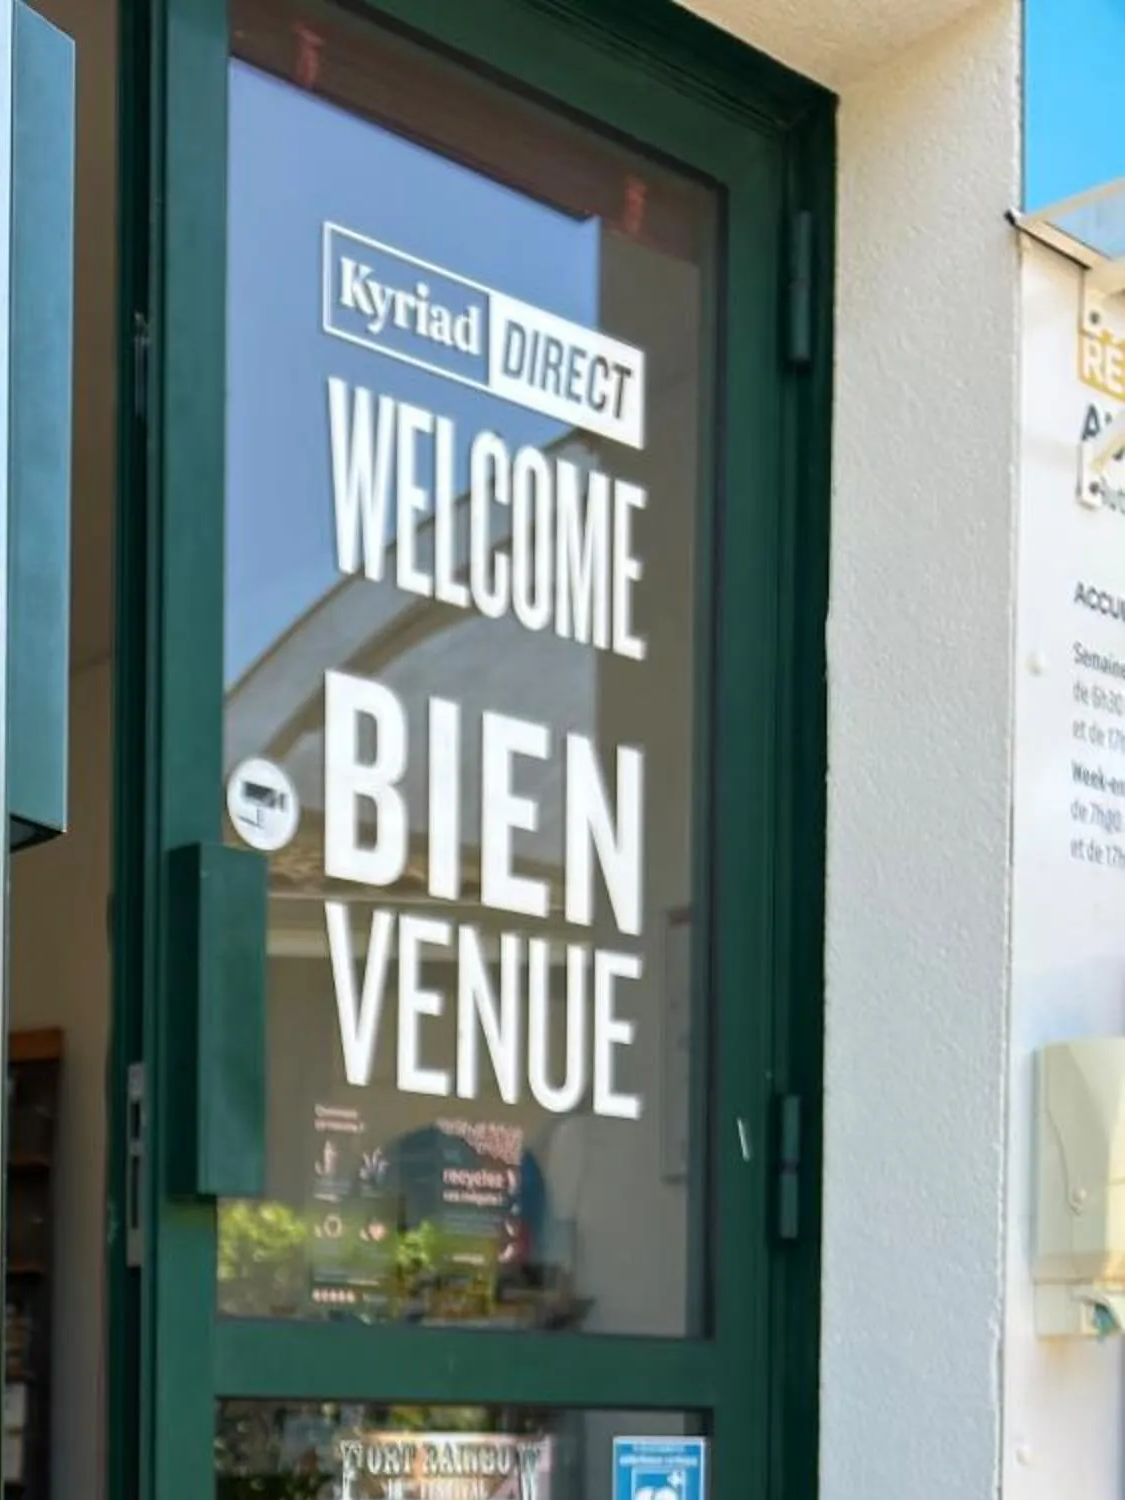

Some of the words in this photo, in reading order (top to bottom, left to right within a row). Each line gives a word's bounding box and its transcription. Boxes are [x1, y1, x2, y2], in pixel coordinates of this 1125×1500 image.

[338, 256, 483, 356] Kyriad
[501, 319, 633, 419] DIRECT
[328, 376, 648, 661] WELCOME
[324, 669, 644, 936] BIEN
[324, 900, 643, 1121] VENUE
